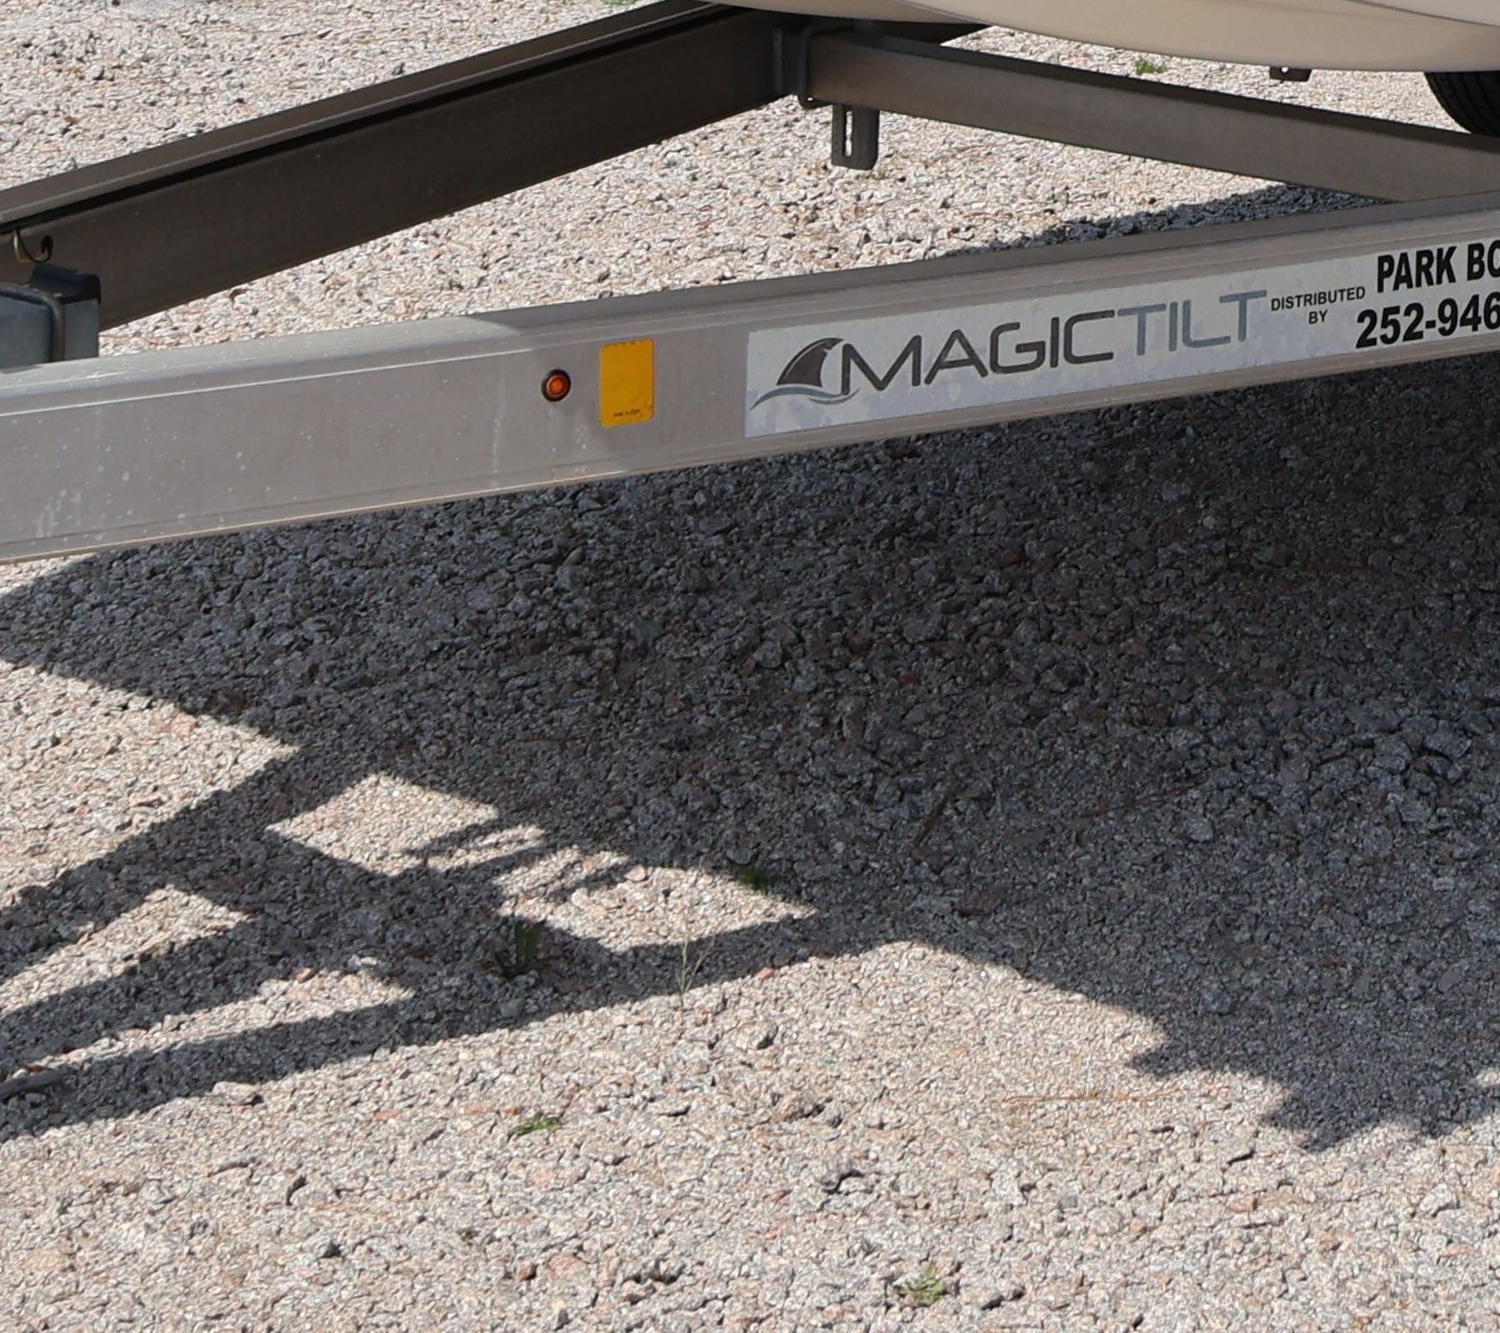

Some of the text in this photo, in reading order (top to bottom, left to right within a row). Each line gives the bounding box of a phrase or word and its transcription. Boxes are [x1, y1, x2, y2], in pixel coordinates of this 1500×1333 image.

[1376, 246, 1456, 293] PARK
[1271, 286, 1366, 311] DISTRIBUTED
[1308, 309, 1328, 324] BY
[841, 289, 1268, 395] MAGICTILT
